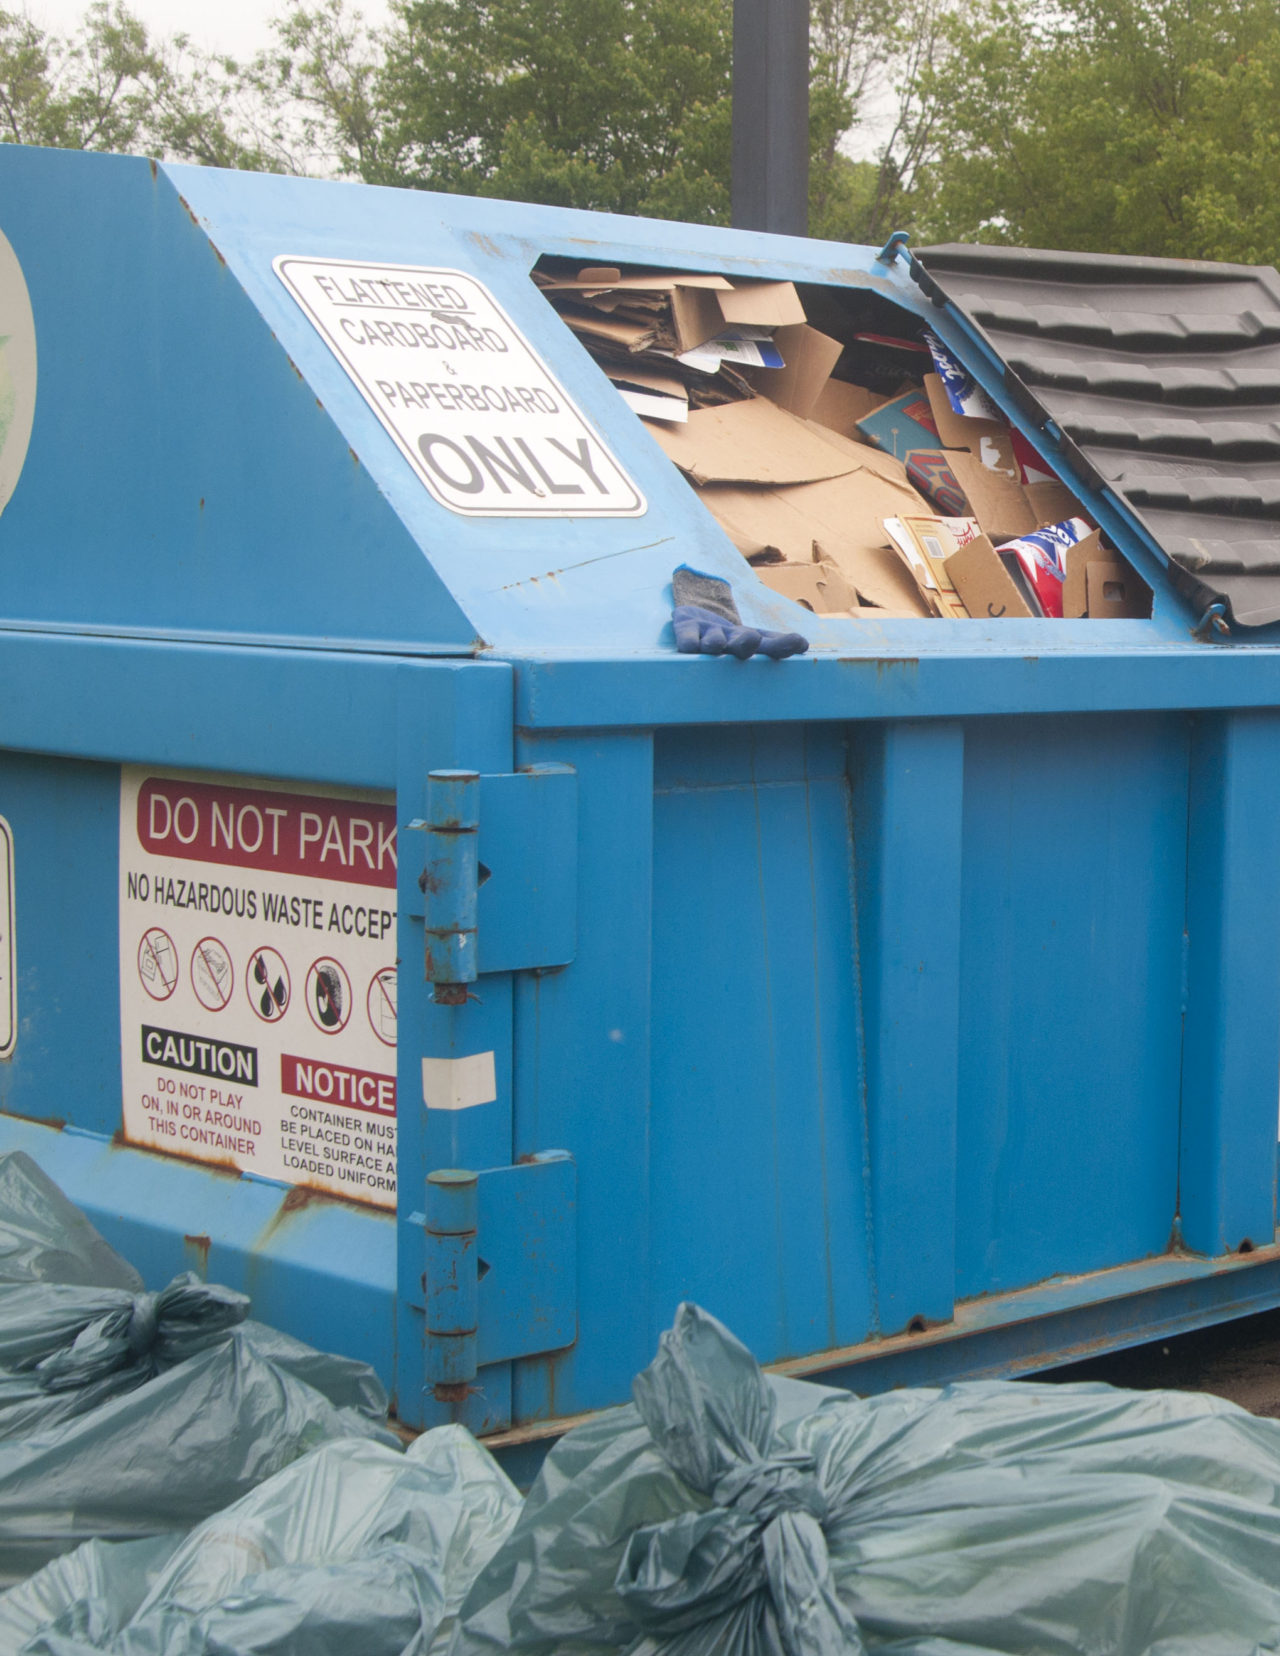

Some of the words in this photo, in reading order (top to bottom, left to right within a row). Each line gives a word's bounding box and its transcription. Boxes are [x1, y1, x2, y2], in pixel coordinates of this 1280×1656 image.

[313, 275, 468, 309] FLATTENED
[339, 318, 508, 352] CARDBOARD
[442, 360, 457, 375] &
[375, 380, 560, 414] PAPERBOARD
[417, 433, 610, 494] ONLY
[149, 794, 199, 844] DO
[211, 801, 288, 856] NOT
[300, 812, 397, 870] PARK
[128, 871, 149, 901] NO
[155, 875, 257, 920] HAZARDOUS
[262, 891, 323, 930] WASTE
[146, 1031, 253, 1081] CAUTION
[157, 1077, 176, 1094] DO
[180, 1082, 206, 1101] NOT
[210, 1089, 243, 1110] PLAY
[296, 1062, 395, 1111] NOTICE
[142, 1094, 164, 1114] ON,
[167, 1101, 179, 1116] IN
[182, 1104, 201, 1122] OR
[205, 1110, 262, 1135] AROUND
[290, 1105, 362, 1132] CONTAINER
[149, 1116, 177, 1136] THIS
[180, 1124, 256, 1156] CONTAINER
[280, 1120, 297, 1134] BE
[300, 1124, 351, 1147] PLACED
[354, 1137, 373, 1151] ON
[281, 1137, 320, 1157] LEVEL
[323, 1147, 382, 1172] SURFACE
[283, 1154, 334, 1177] LOADED
